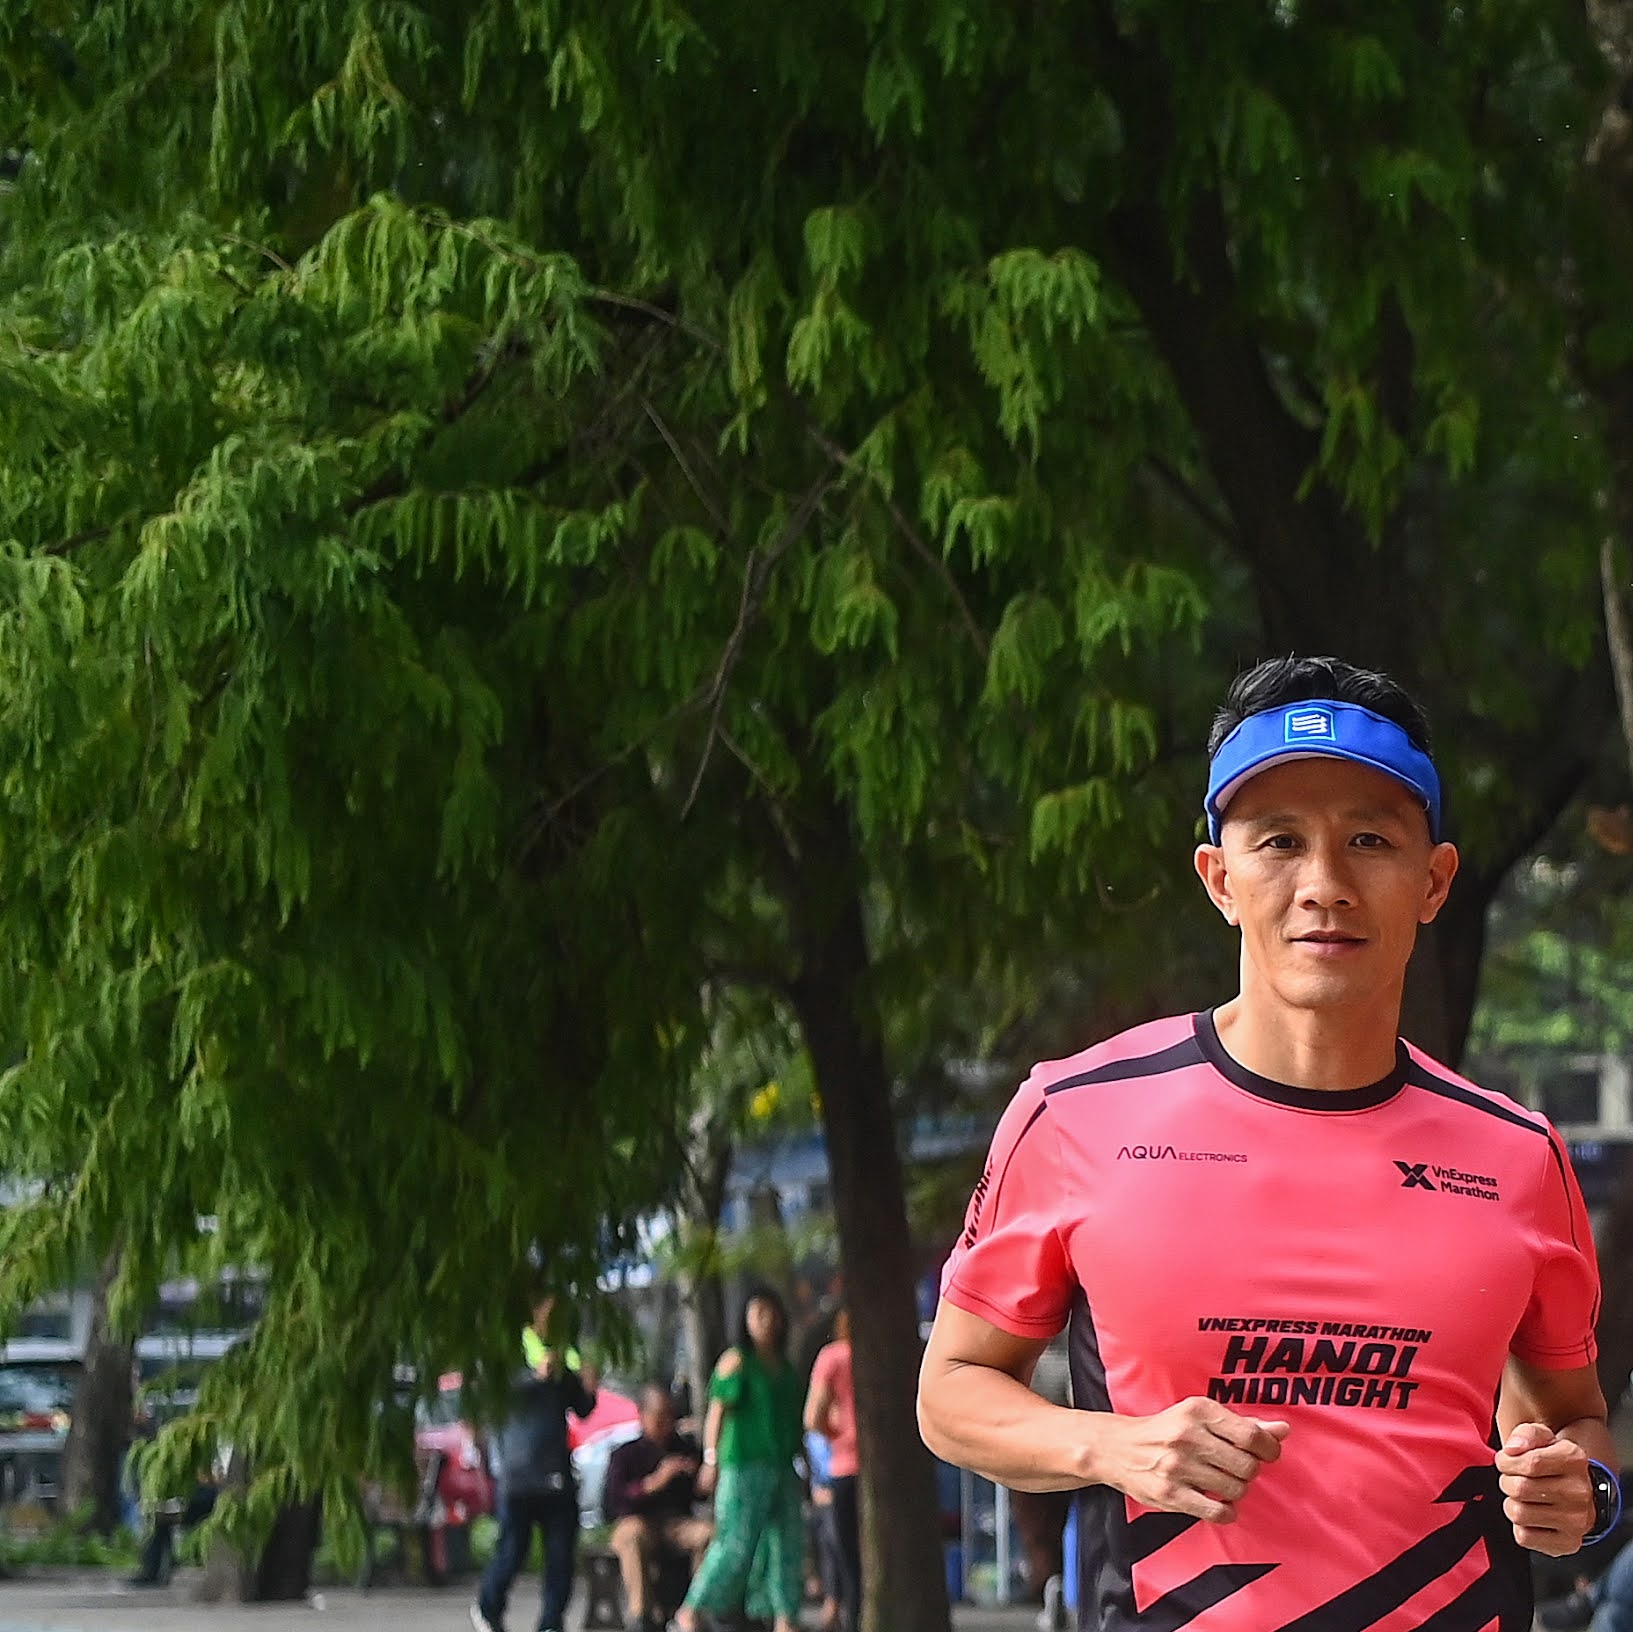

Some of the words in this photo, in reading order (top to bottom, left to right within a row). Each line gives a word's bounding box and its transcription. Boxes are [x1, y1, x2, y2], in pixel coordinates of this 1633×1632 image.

[1117, 1145, 1177, 1160] AQUA
[1179, 1151, 1248, 1163] ELECTRONICS
[1432, 1165, 1498, 1187] VnExpress
[1440, 1180, 1500, 1201] Marathon
[1198, 1317, 1319, 1335] VNEXPRESS
[1321, 1322, 1433, 1343] MARATHON
[1221, 1336, 1418, 1377] HANOI
[1206, 1376, 1420, 1409] MIDNIGHT
